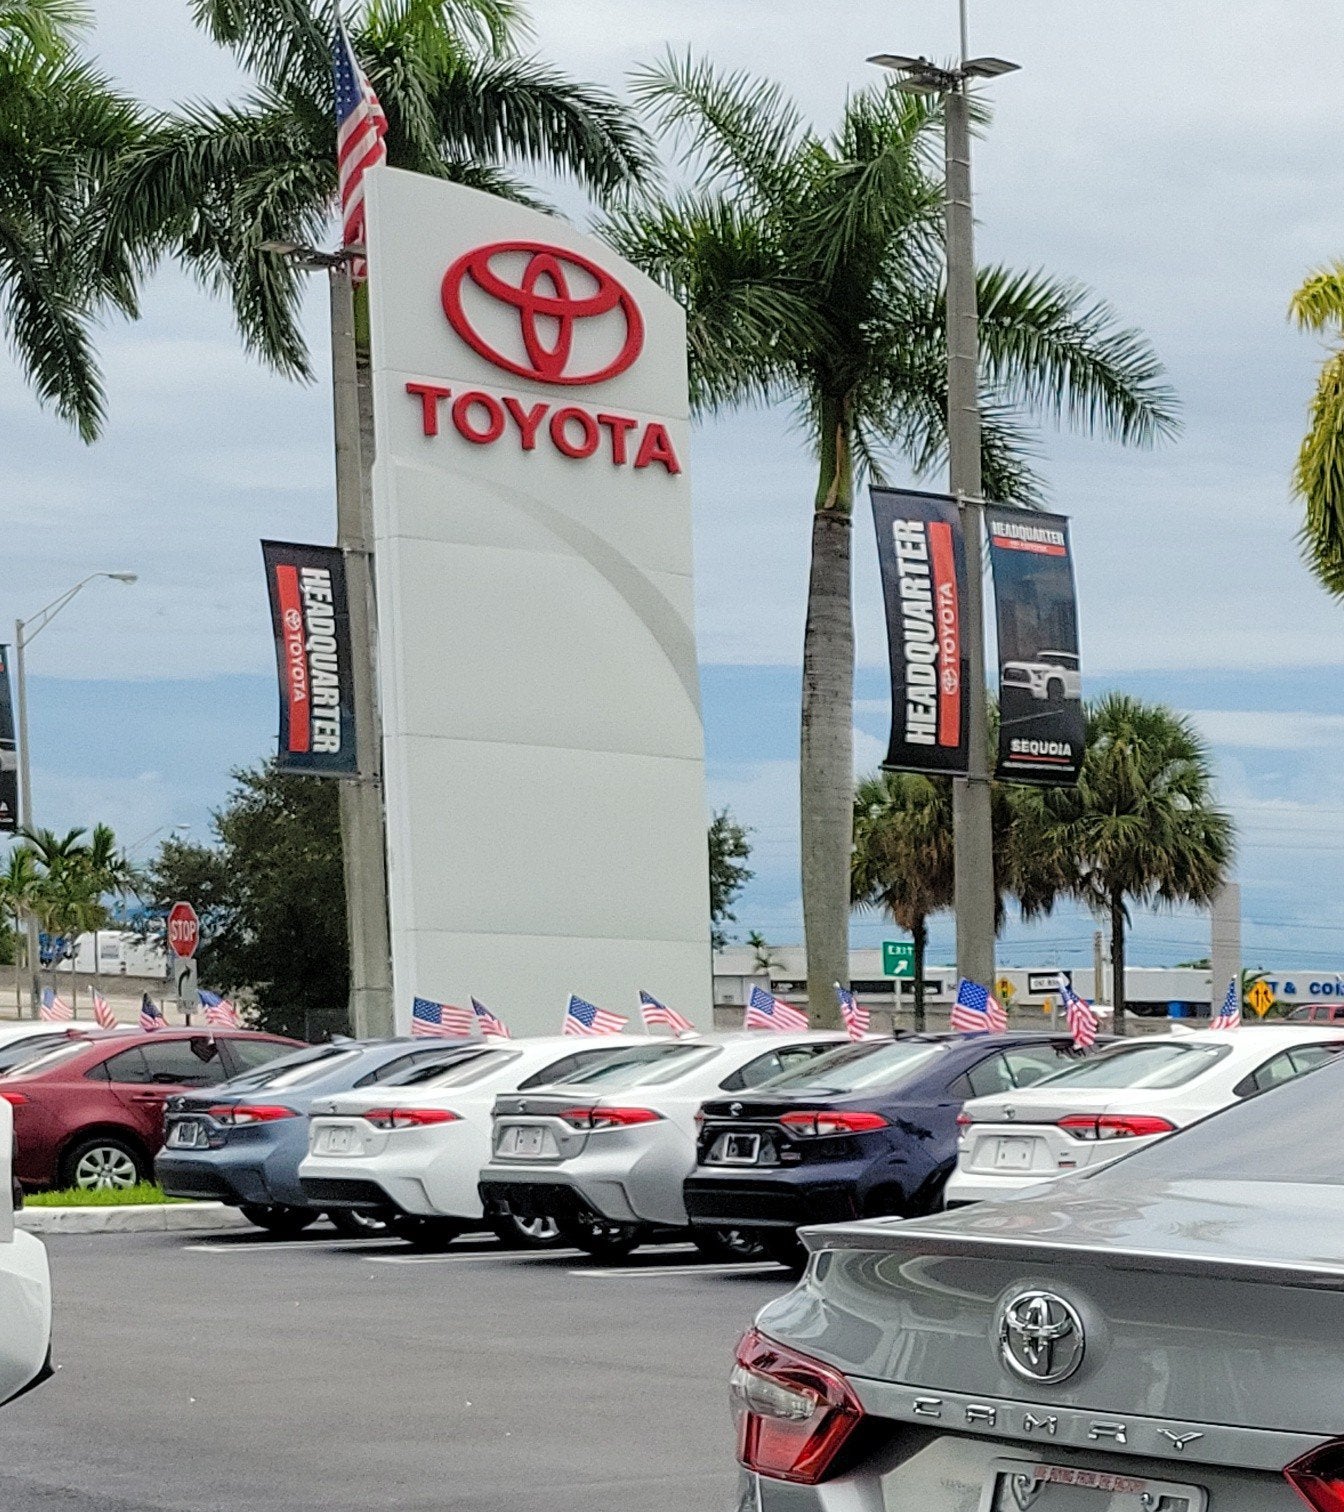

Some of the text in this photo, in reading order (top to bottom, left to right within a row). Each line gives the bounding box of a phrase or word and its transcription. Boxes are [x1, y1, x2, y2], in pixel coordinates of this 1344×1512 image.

[405, 382, 682, 475] TOYOTA
[991, 520, 1065, 546] HEADQUARTER
[893, 519, 938, 746] HEADQUARTER
[940, 582, 955, 665] TOYOTA
[289, 632, 307, 702] TOYOTA
[301, 566, 342, 754] HEADQUARTER
[1010, 738, 1072, 756] SEQUOIA
[170, 920, 196, 941] STOP
[912, 1397, 1205, 1451] CAMRY
